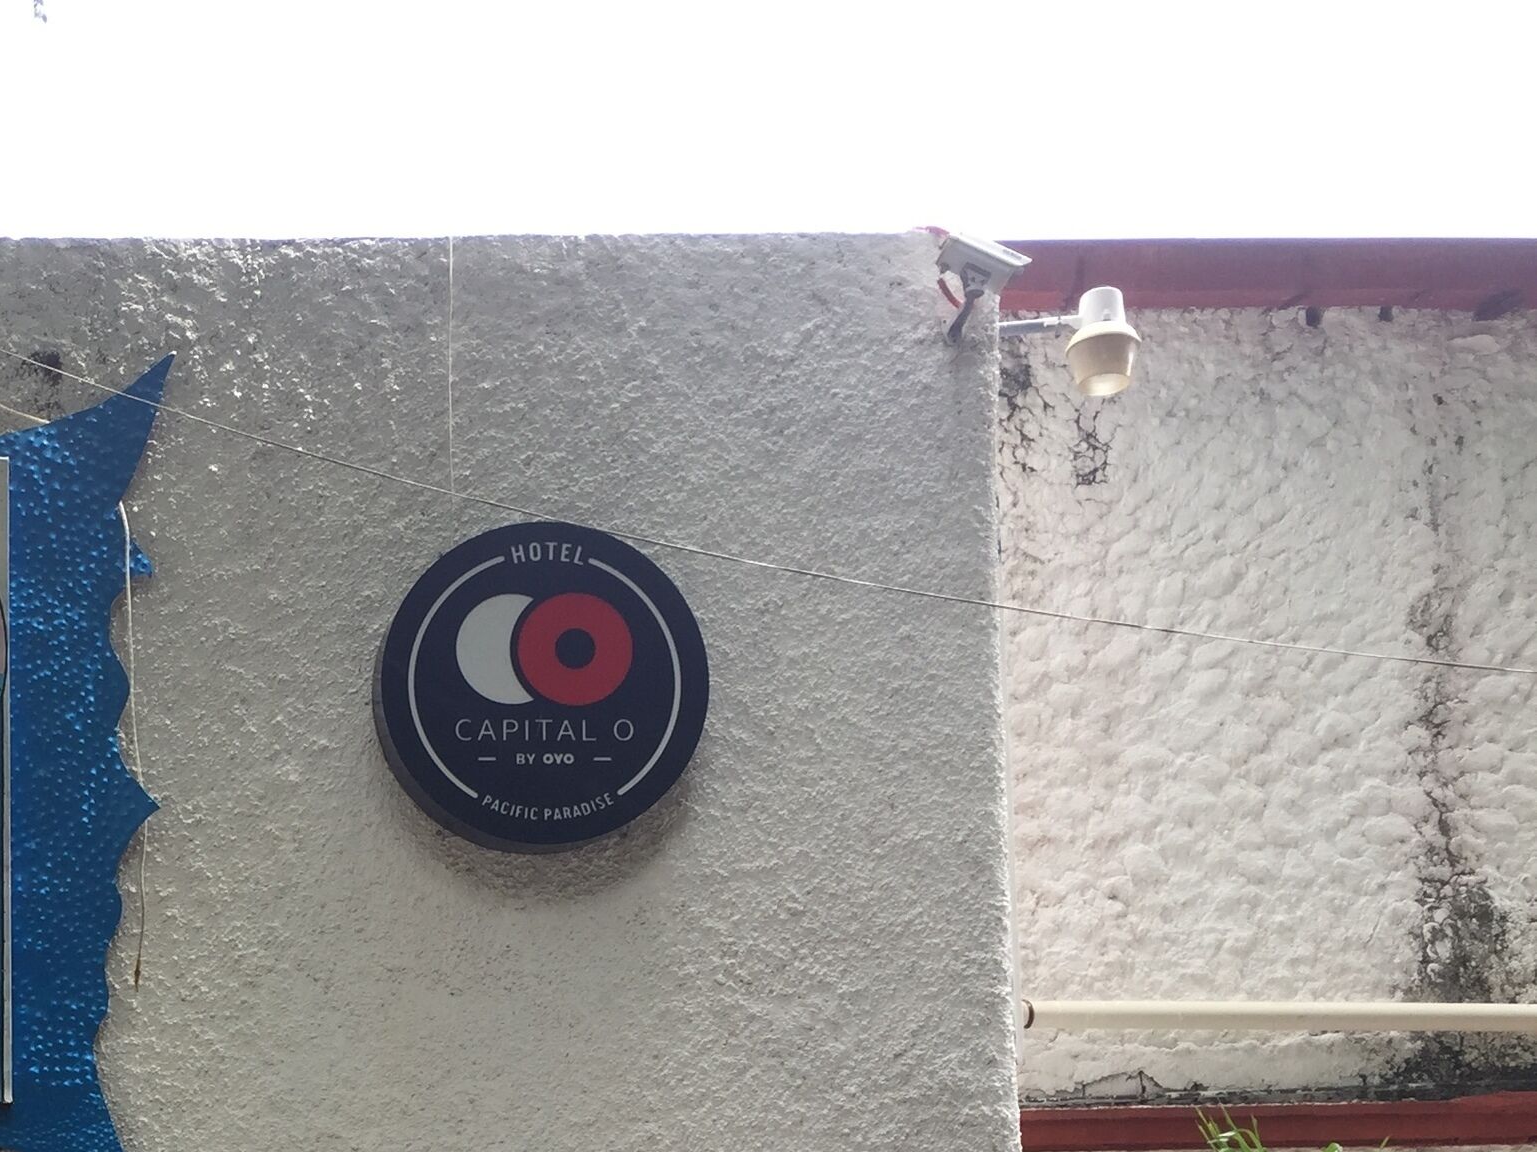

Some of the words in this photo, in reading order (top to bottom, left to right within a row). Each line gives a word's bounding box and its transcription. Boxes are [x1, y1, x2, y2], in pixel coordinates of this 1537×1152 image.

[511, 541, 585, 566] HOTEL
[455, 718, 597, 742] CAPITAL
[613, 718, 635, 742] O
[516, 753, 536, 765] BY
[543, 752, 575, 765] OYO
[481, 794, 539, 821] PACIFIC
[543, 791, 615, 821] PARADISE
